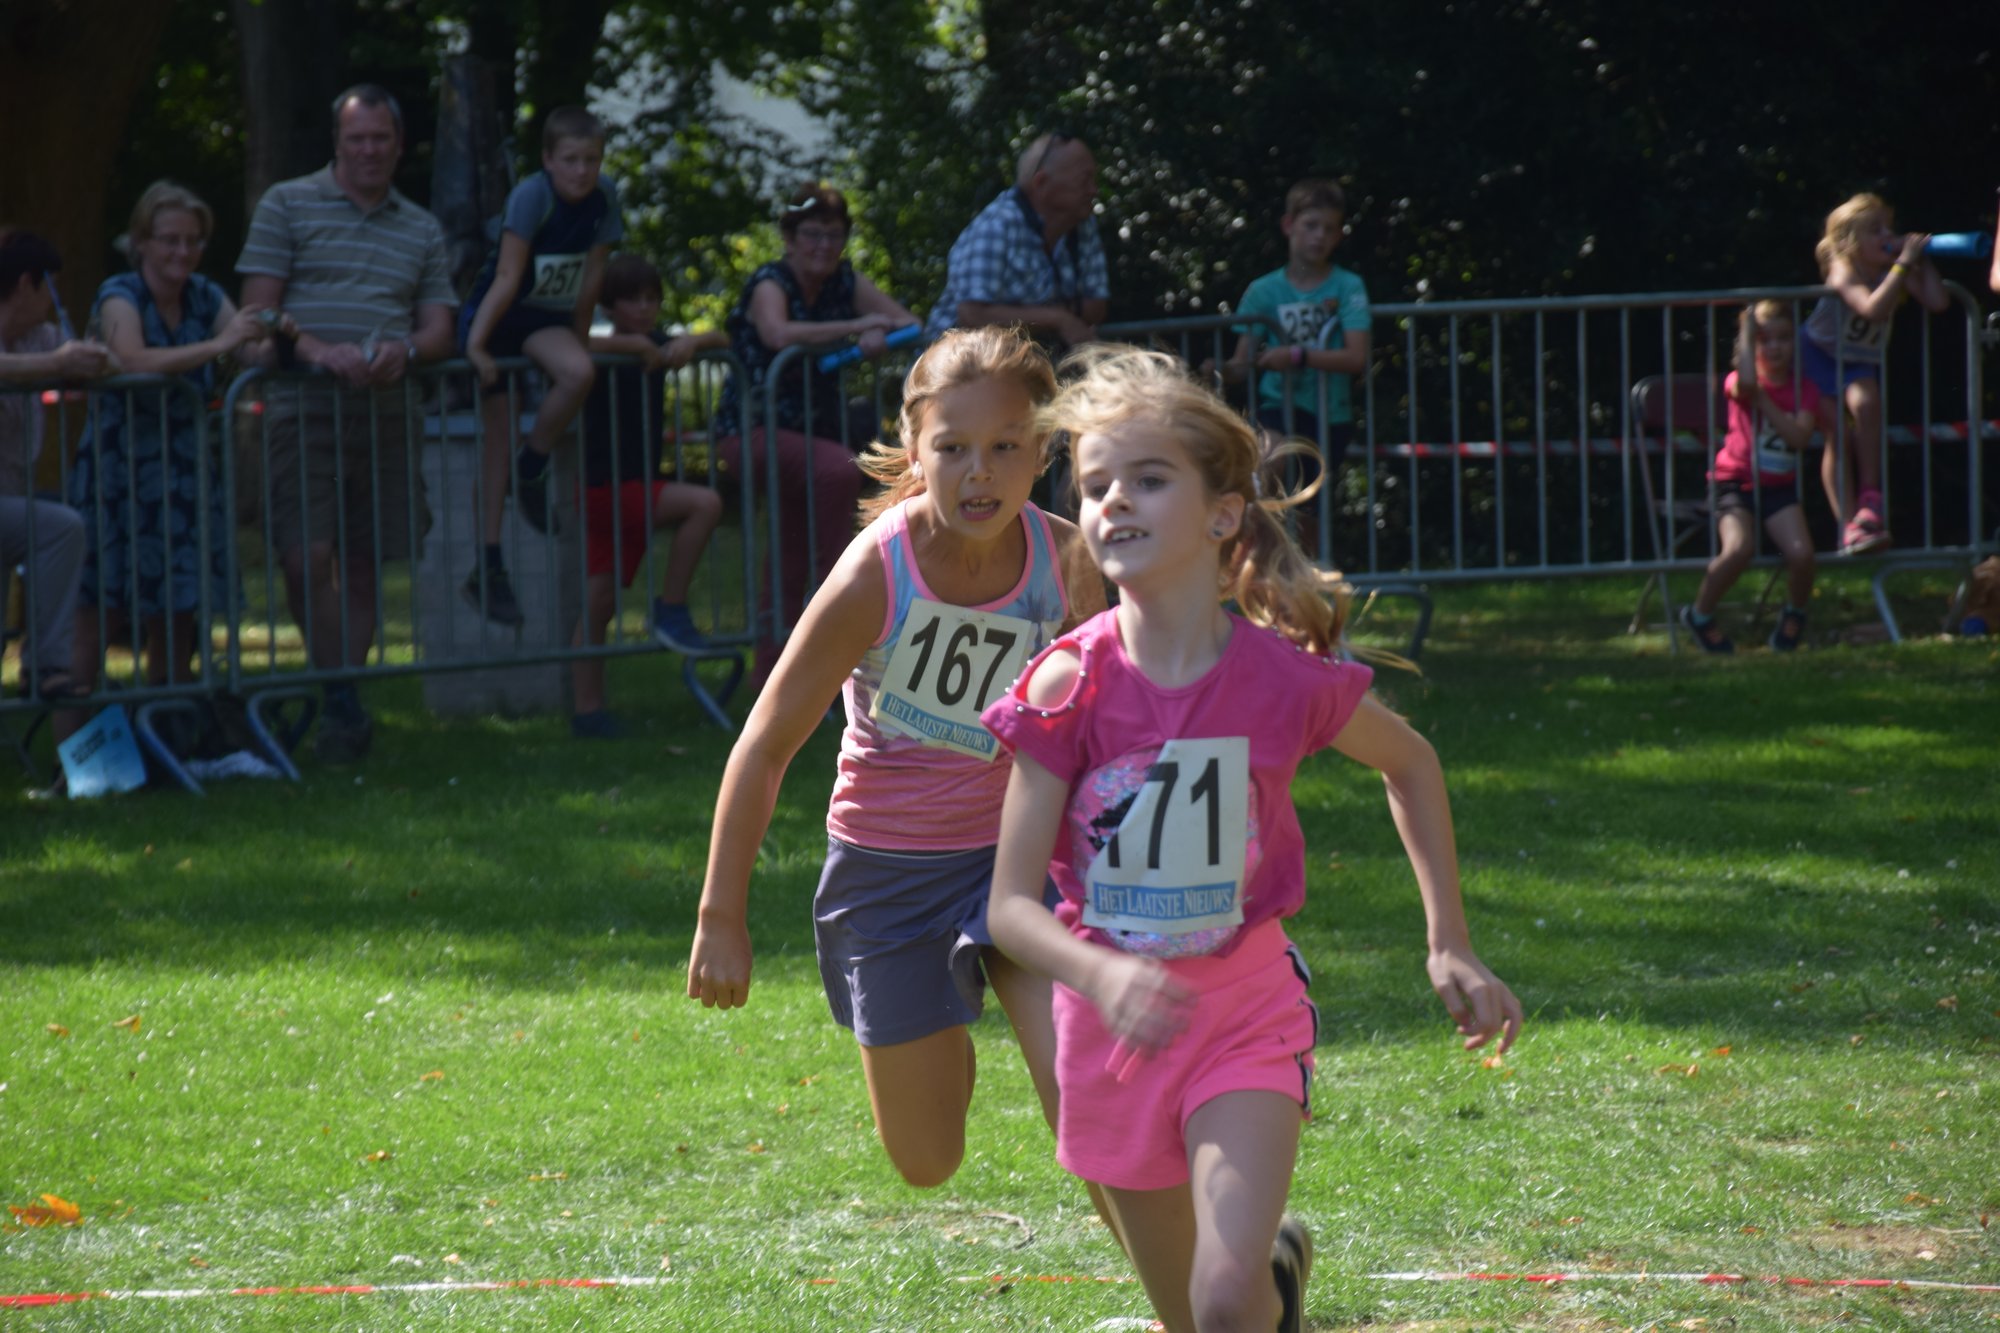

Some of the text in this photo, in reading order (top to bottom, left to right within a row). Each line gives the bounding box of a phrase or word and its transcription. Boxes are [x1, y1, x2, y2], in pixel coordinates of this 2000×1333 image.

[536, 260, 583, 296] 257
[910, 616, 1018, 712] 167
[886, 695, 991, 751] HET LAATSTE NIEUWS
[1098, 885, 1232, 917] HET LAATSTE NIEUWS
